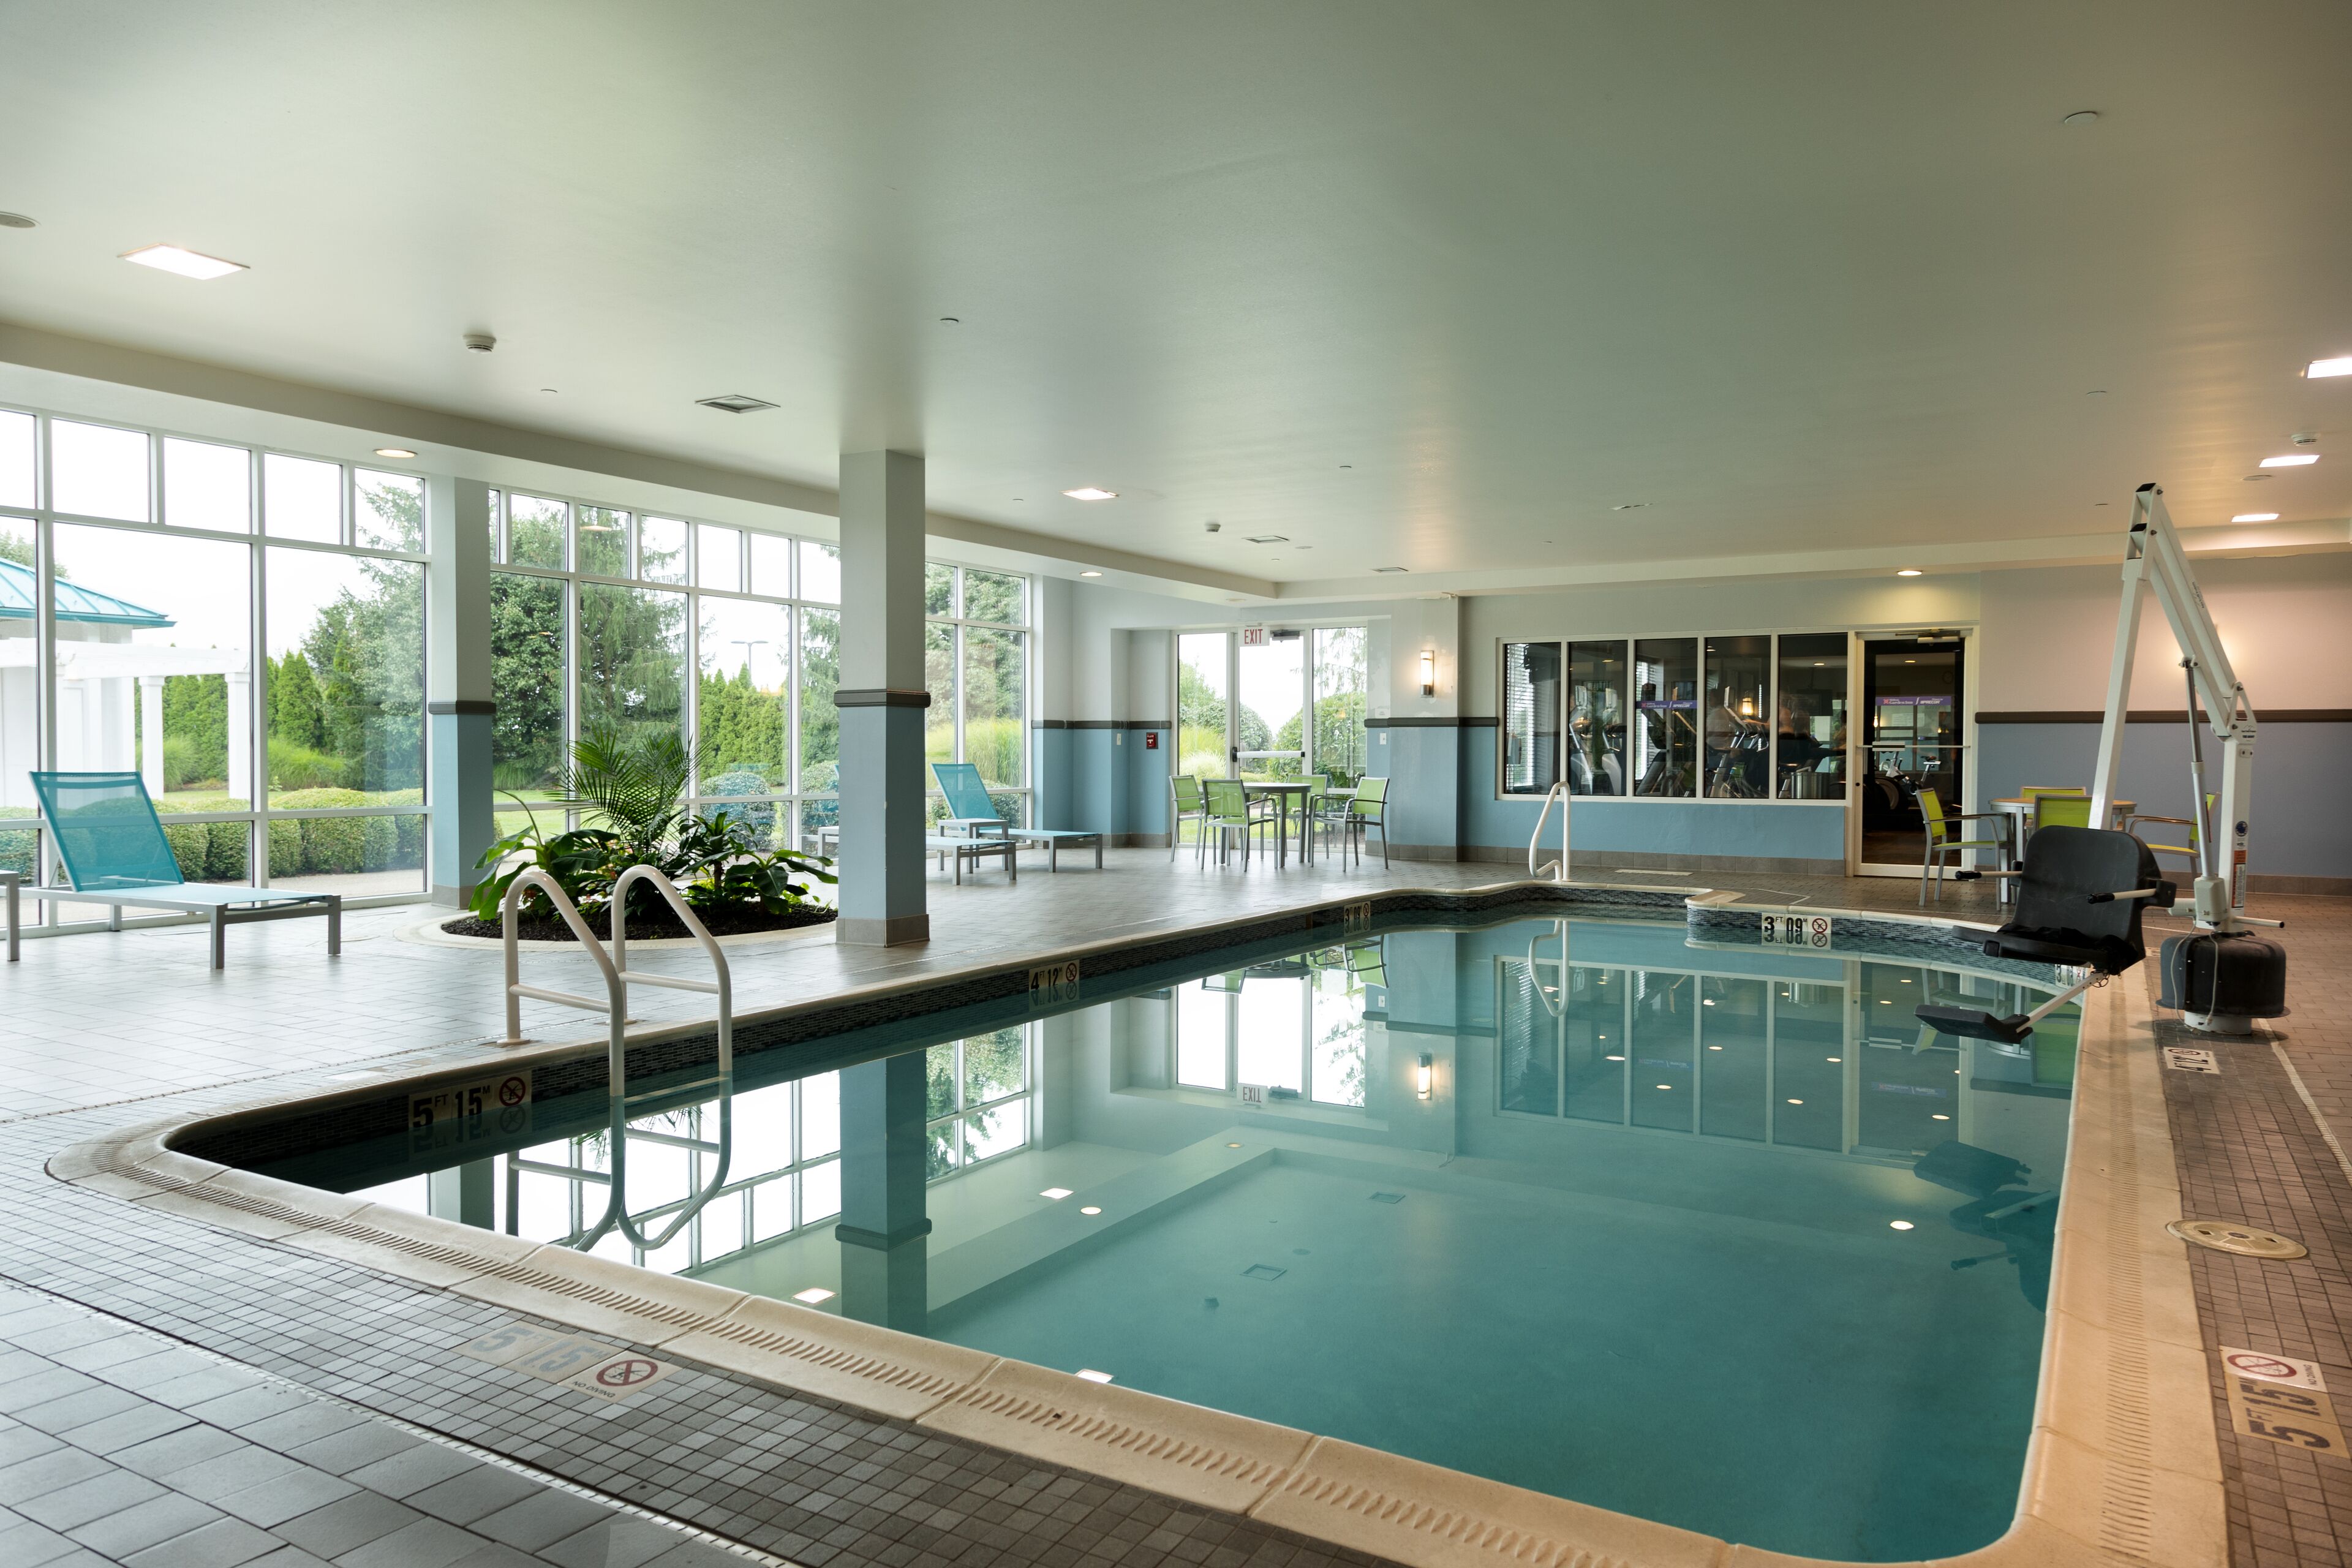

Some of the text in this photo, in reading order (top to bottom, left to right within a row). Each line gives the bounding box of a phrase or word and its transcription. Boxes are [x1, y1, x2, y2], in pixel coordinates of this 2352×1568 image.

[1244, 628, 1263, 644] EXIT
[2303, 1364, 2315, 1378] DIVING
[586, 1385, 616, 1398] DIVING
